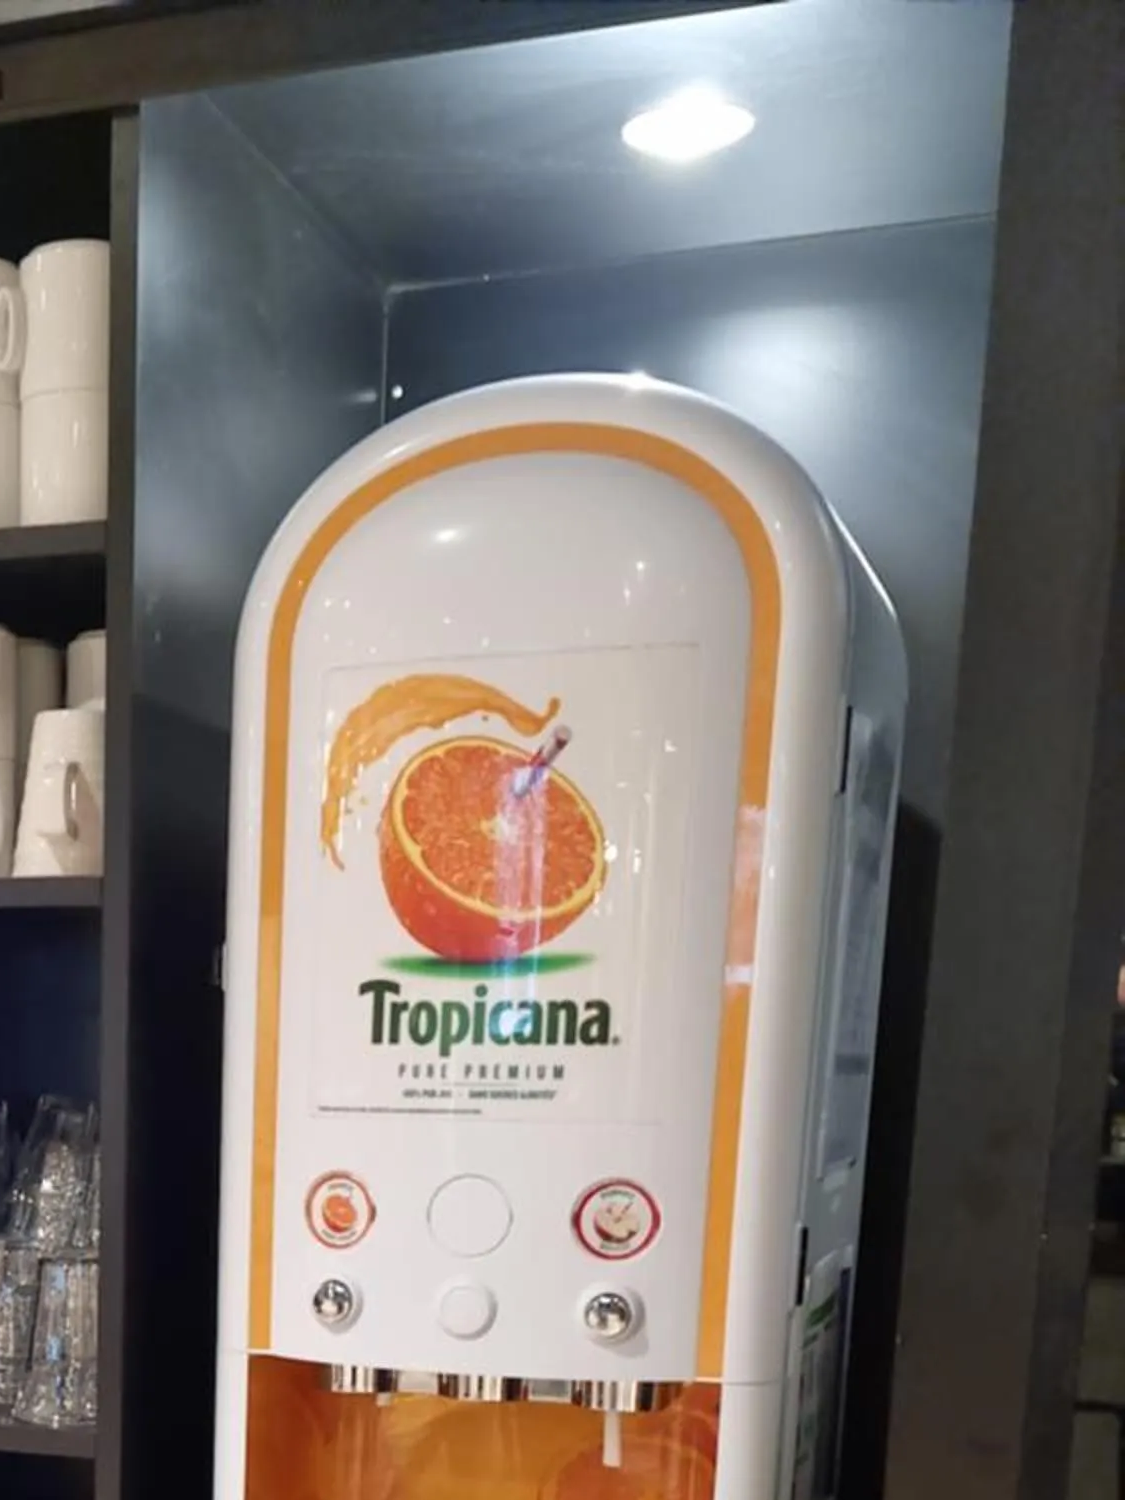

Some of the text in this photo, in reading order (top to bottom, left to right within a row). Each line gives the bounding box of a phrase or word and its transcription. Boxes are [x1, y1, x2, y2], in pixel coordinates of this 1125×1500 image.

[358, 979, 611, 1057] Tropicana
[398, 1063, 565, 1080] PURE PREMIUM
